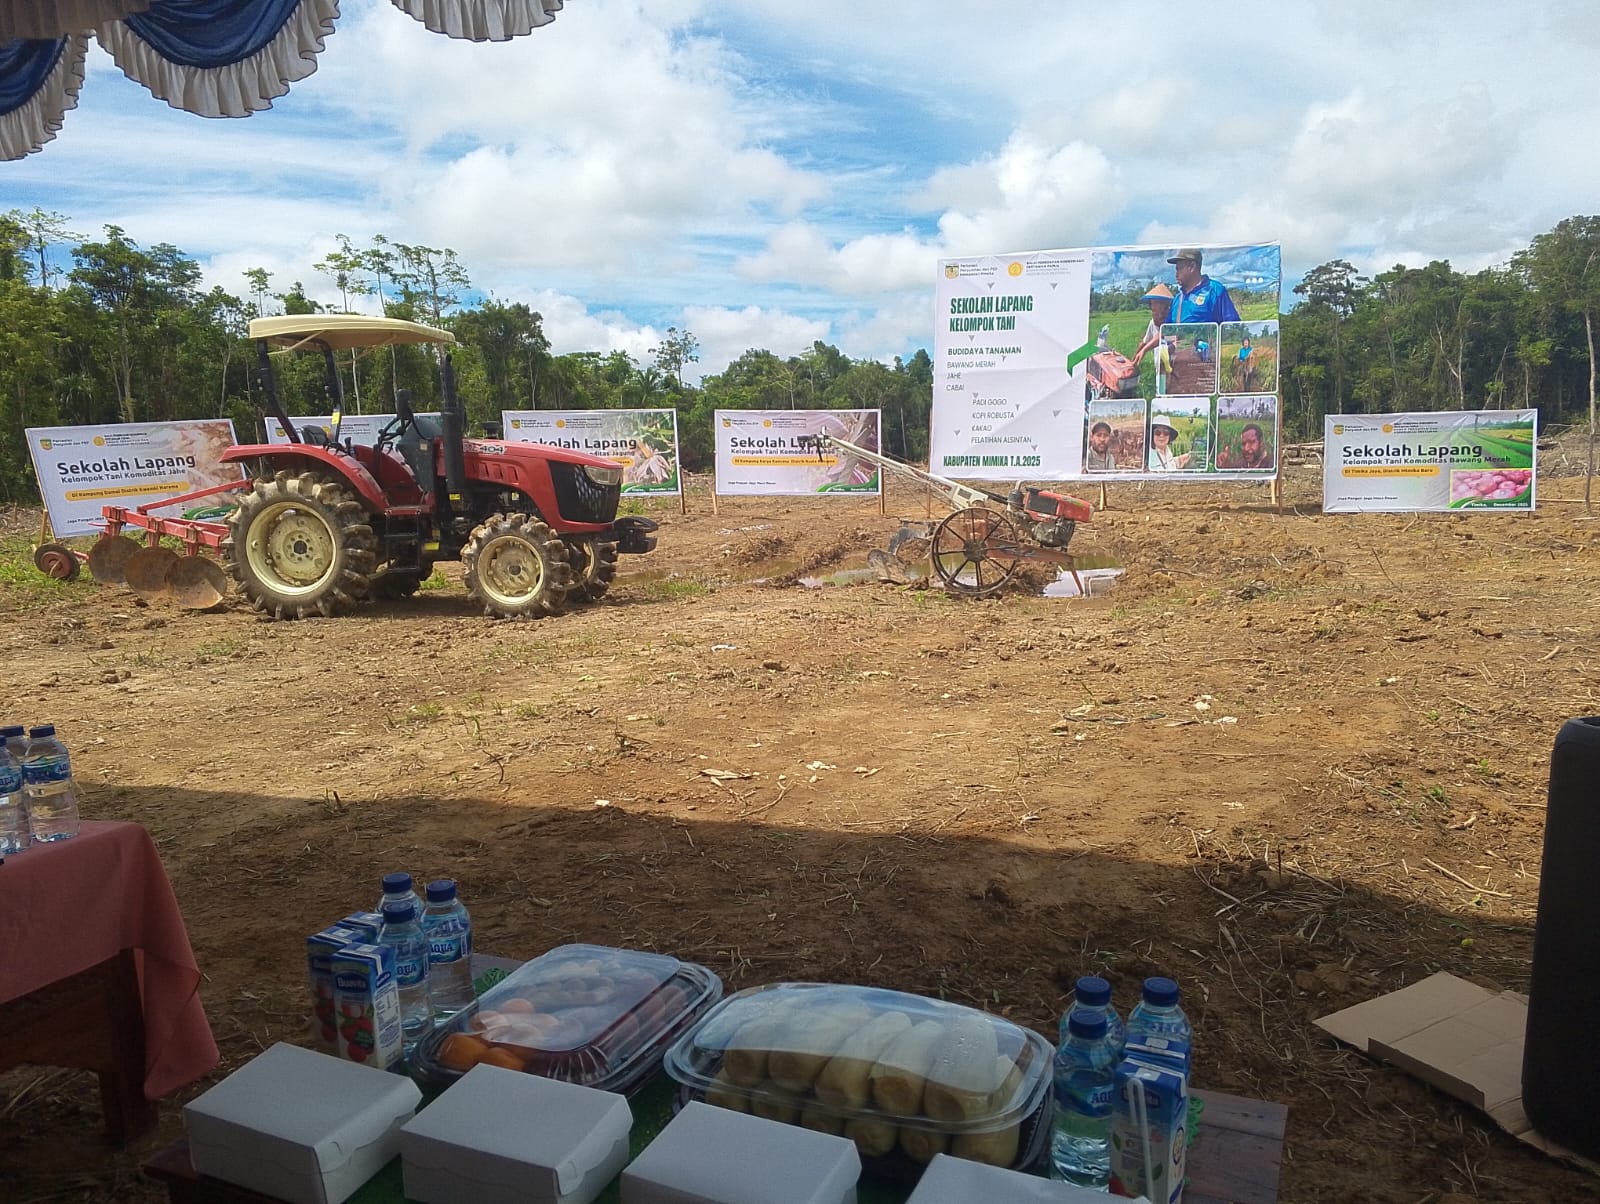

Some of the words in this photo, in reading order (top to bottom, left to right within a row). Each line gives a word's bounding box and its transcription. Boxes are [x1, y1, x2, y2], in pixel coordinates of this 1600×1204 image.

[950, 296, 993, 314] SEKOLAH
[996, 295, 1033, 312] LAPANG
[950, 316, 994, 332] KELOMPOK
[996, 316, 1016, 330] TANI
[948, 348, 985, 356] BUDIDAYA
[986, 346, 1022, 355] TANAMAN
[521, 438, 580, 449] kolah
[585, 438, 637, 450] Lapang
[730, 437, 786, 448] Sekolah
[1342, 444, 1412, 457] Sekolah
[1418, 444, 1482, 458] Lapang
[57, 459, 130, 475] Sekolah
[134, 456, 196, 470] Lapang
[943, 456, 980, 466] KABUPATEN
[982, 456, 1008, 466] MIMIKA
[1010, 456, 1040, 466] T.A.2025
[62, 474, 103, 484] Kelompok
[105, 473, 122, 481] Tani
[124, 470, 166, 479] Komoditas
[168, 468, 186, 476] Jahe
[396, 964, 417, 976] QUA
